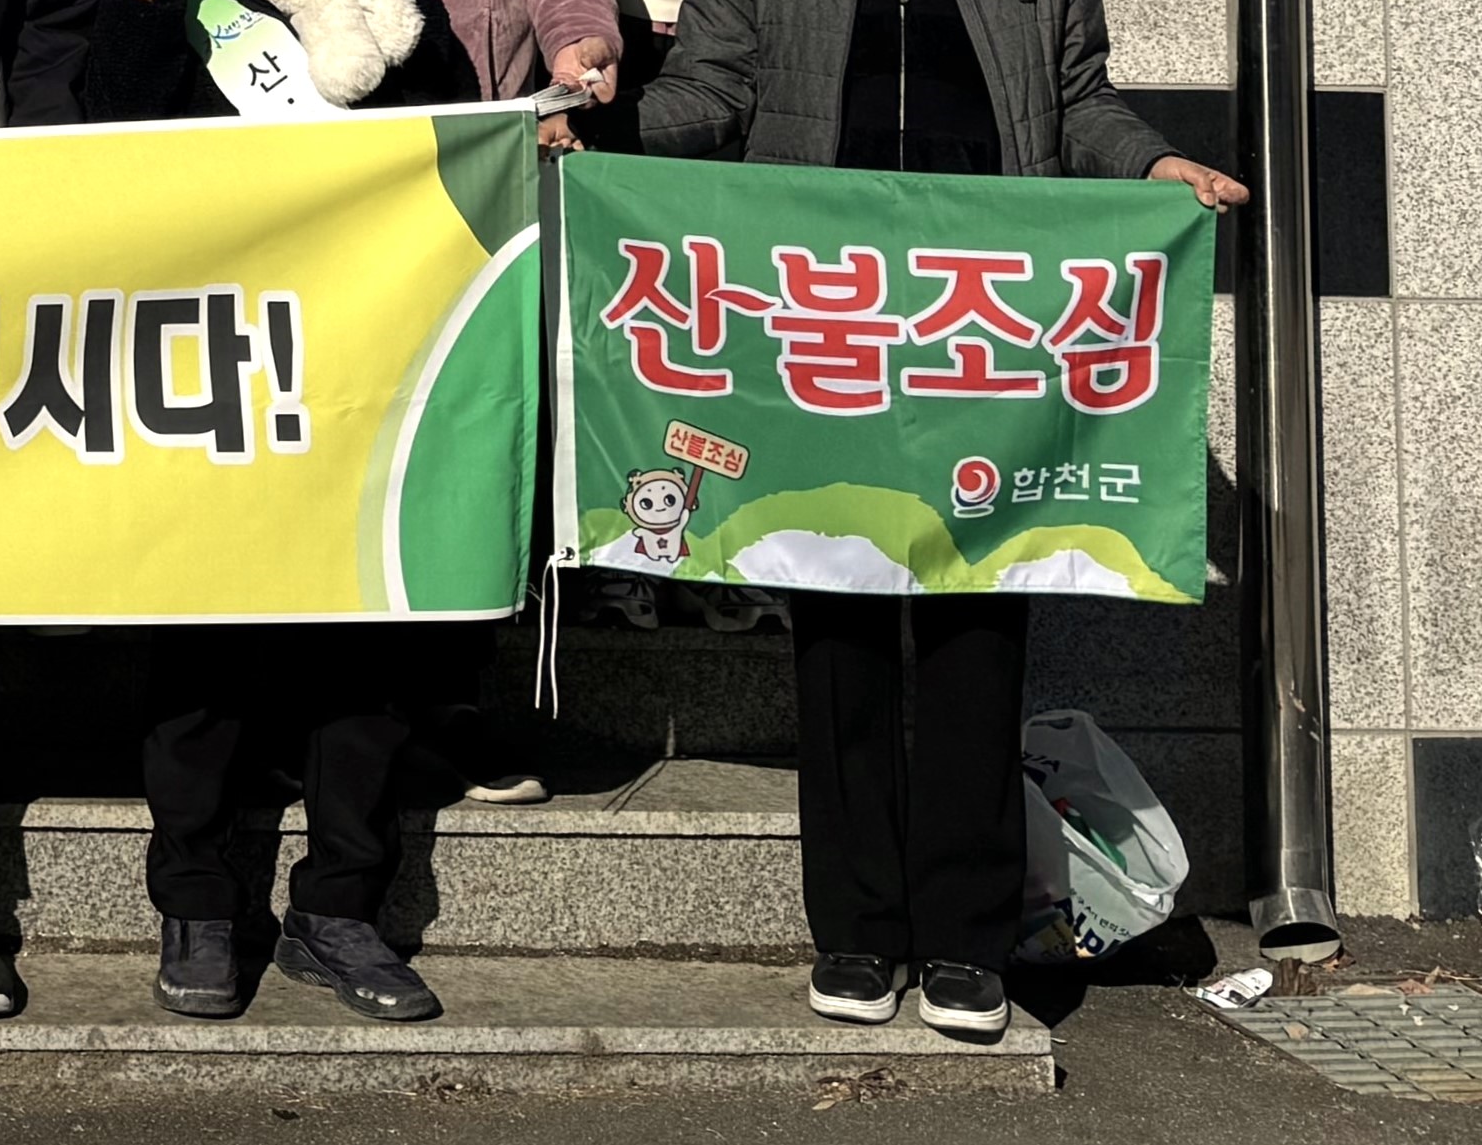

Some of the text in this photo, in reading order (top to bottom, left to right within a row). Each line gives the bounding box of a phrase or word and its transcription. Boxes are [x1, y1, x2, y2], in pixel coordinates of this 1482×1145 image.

[602, 235, 1167, 415] 산불조심
[670, 427, 745, 474] 산불조심
[1011, 462, 1142, 504] 합천군
